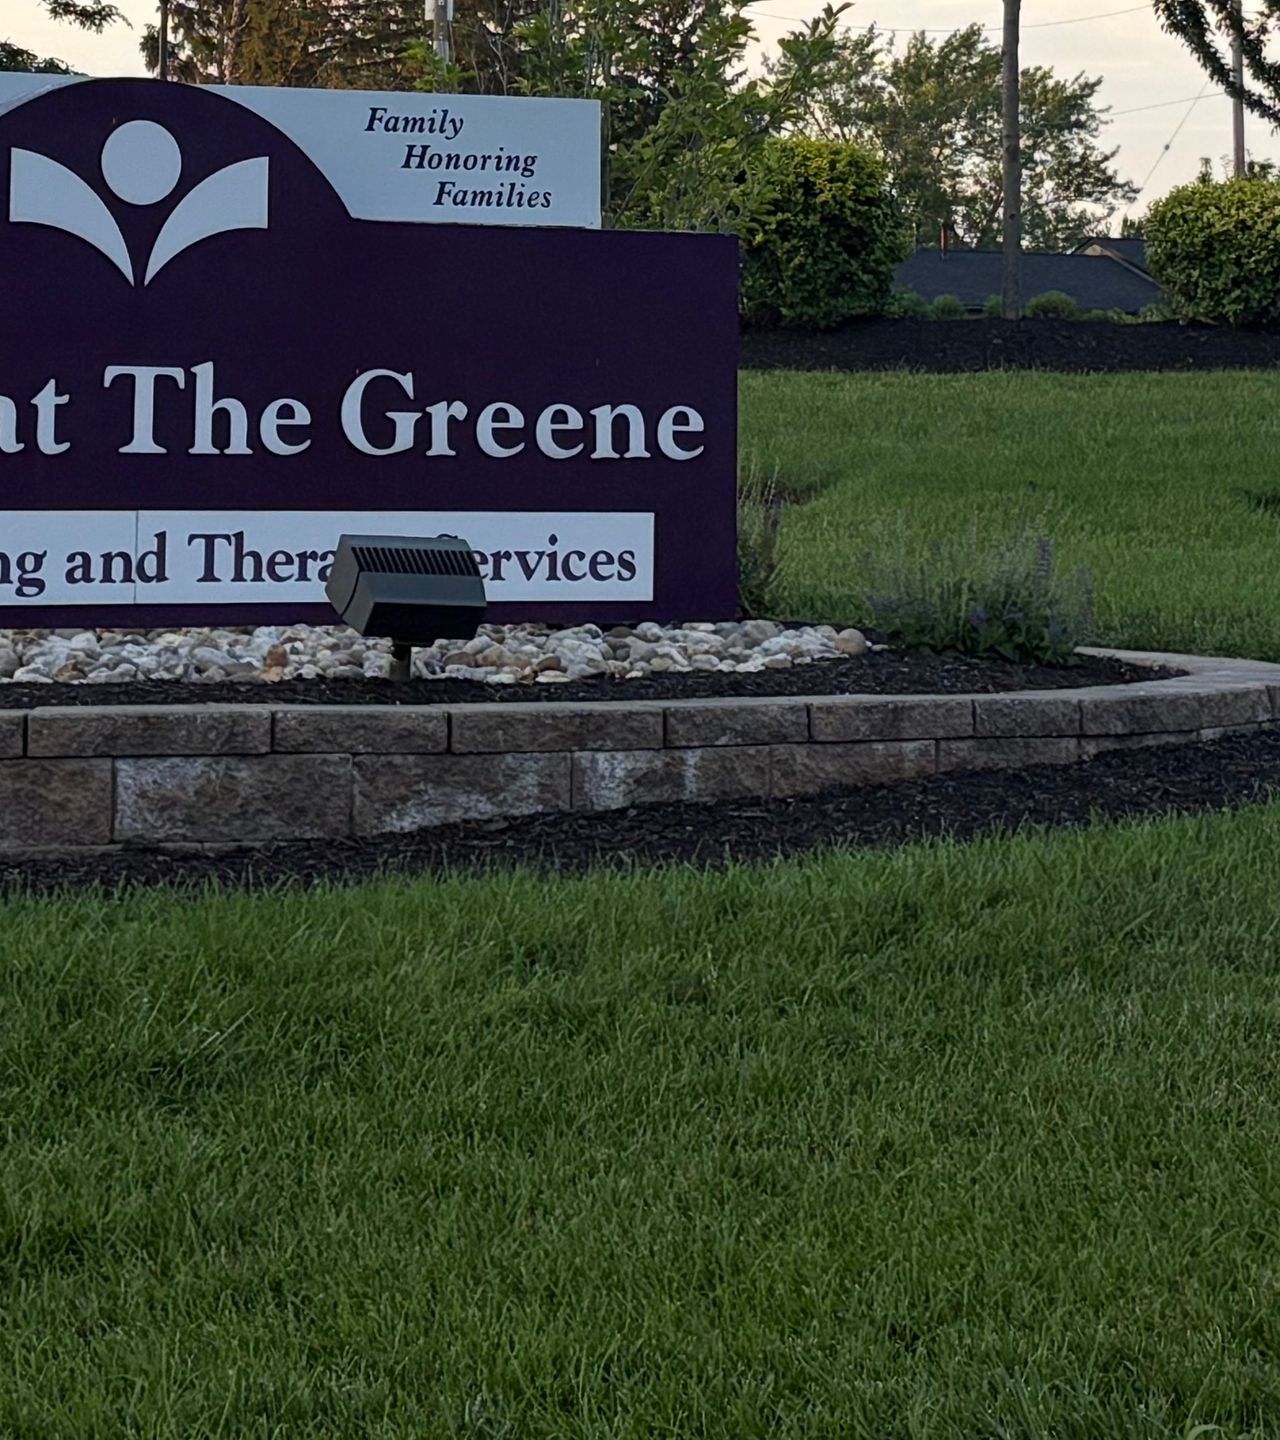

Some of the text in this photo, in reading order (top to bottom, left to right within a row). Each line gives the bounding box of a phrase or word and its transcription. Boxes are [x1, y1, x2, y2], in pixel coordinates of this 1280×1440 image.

[364, 107, 464, 140] Family
[400, 144, 538, 178] Honoring
[432, 181, 552, 209] Families
[103, 361, 312, 456] The
[340, 368, 705, 461] Greene
[64, 530, 167, 585] and
[187, 530, 336, 584] Ther
[437, 532, 637, 583] rvices
